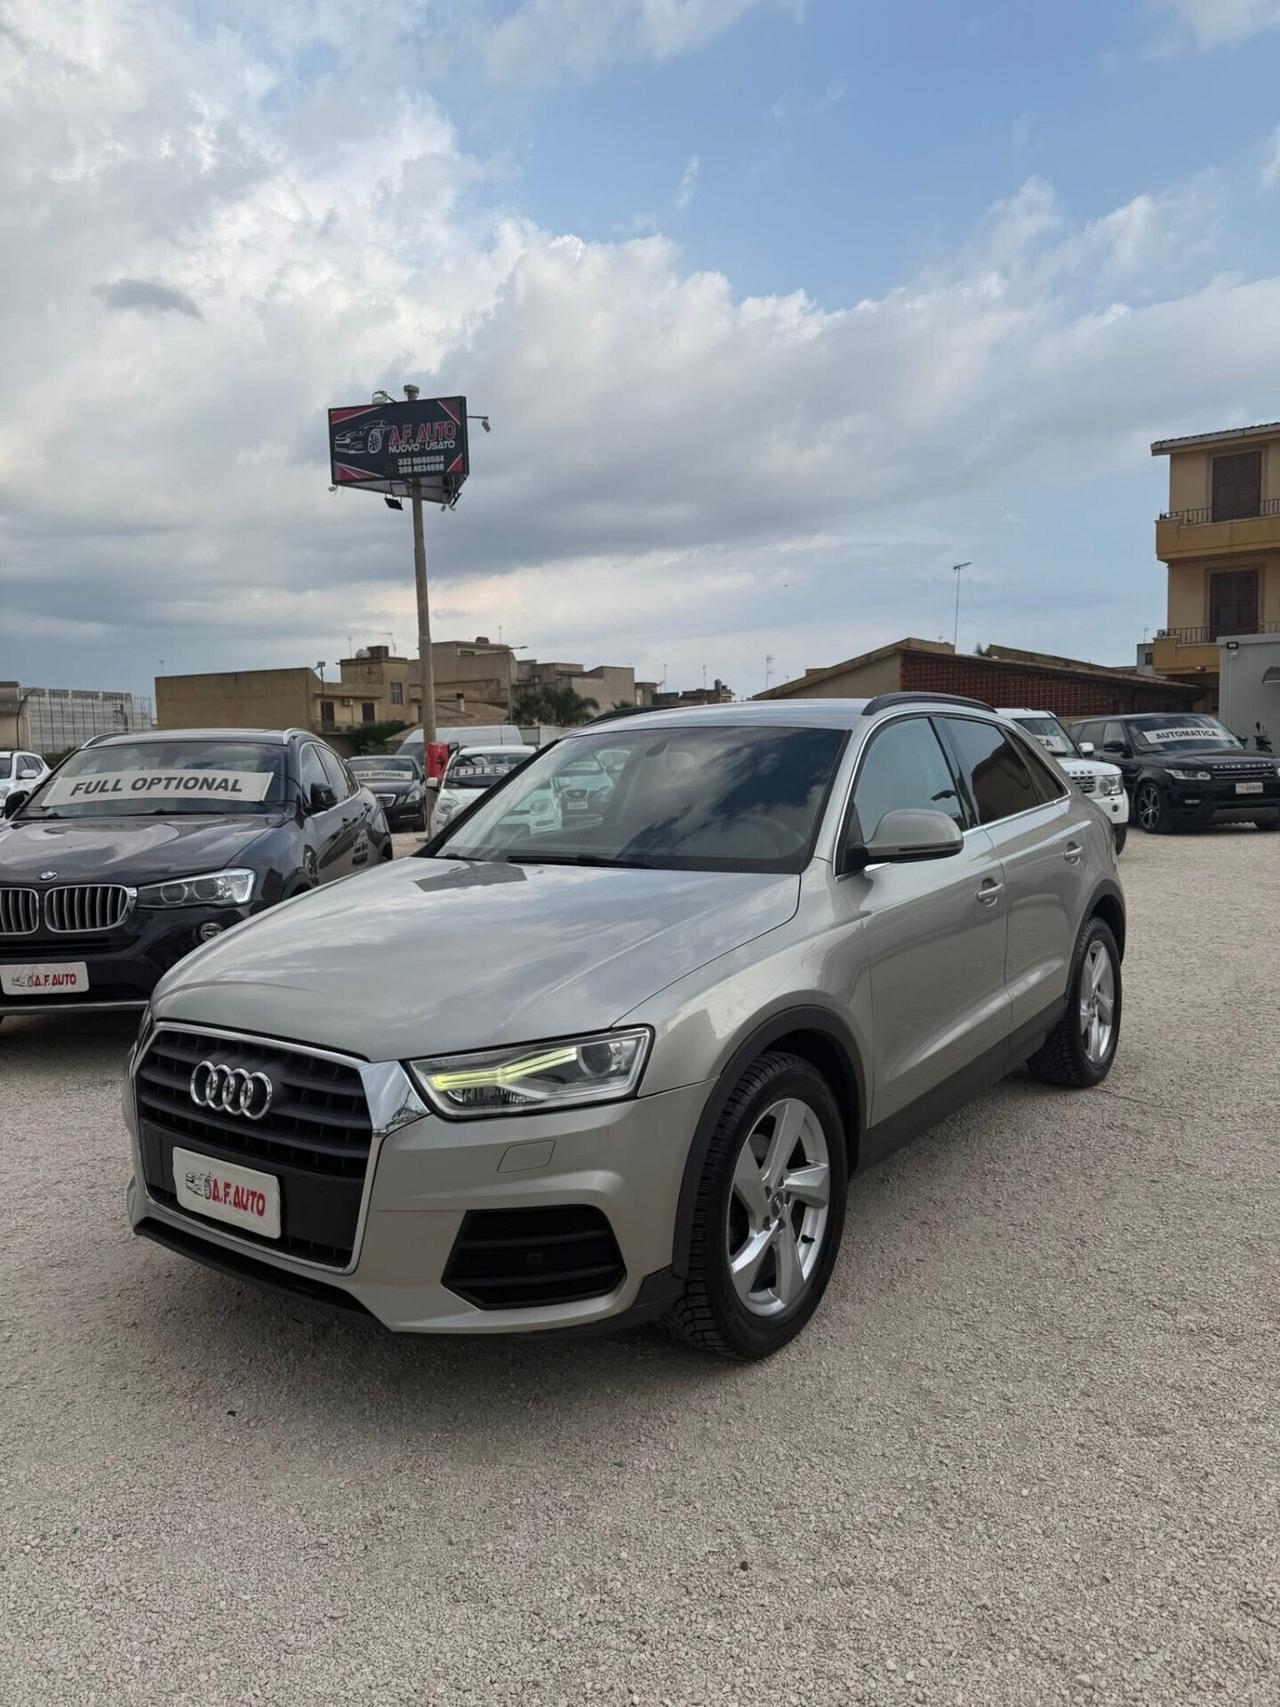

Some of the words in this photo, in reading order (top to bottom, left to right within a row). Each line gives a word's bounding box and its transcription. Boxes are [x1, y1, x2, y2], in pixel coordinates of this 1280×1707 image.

[389, 444, 420, 453] NUOVO
[425, 440, 456, 450] USATO
[1156, 729, 1219, 739] AUTOMATICA
[70, 779, 123, 796] FULL
[131, 777, 242, 792] OPTIONAL
